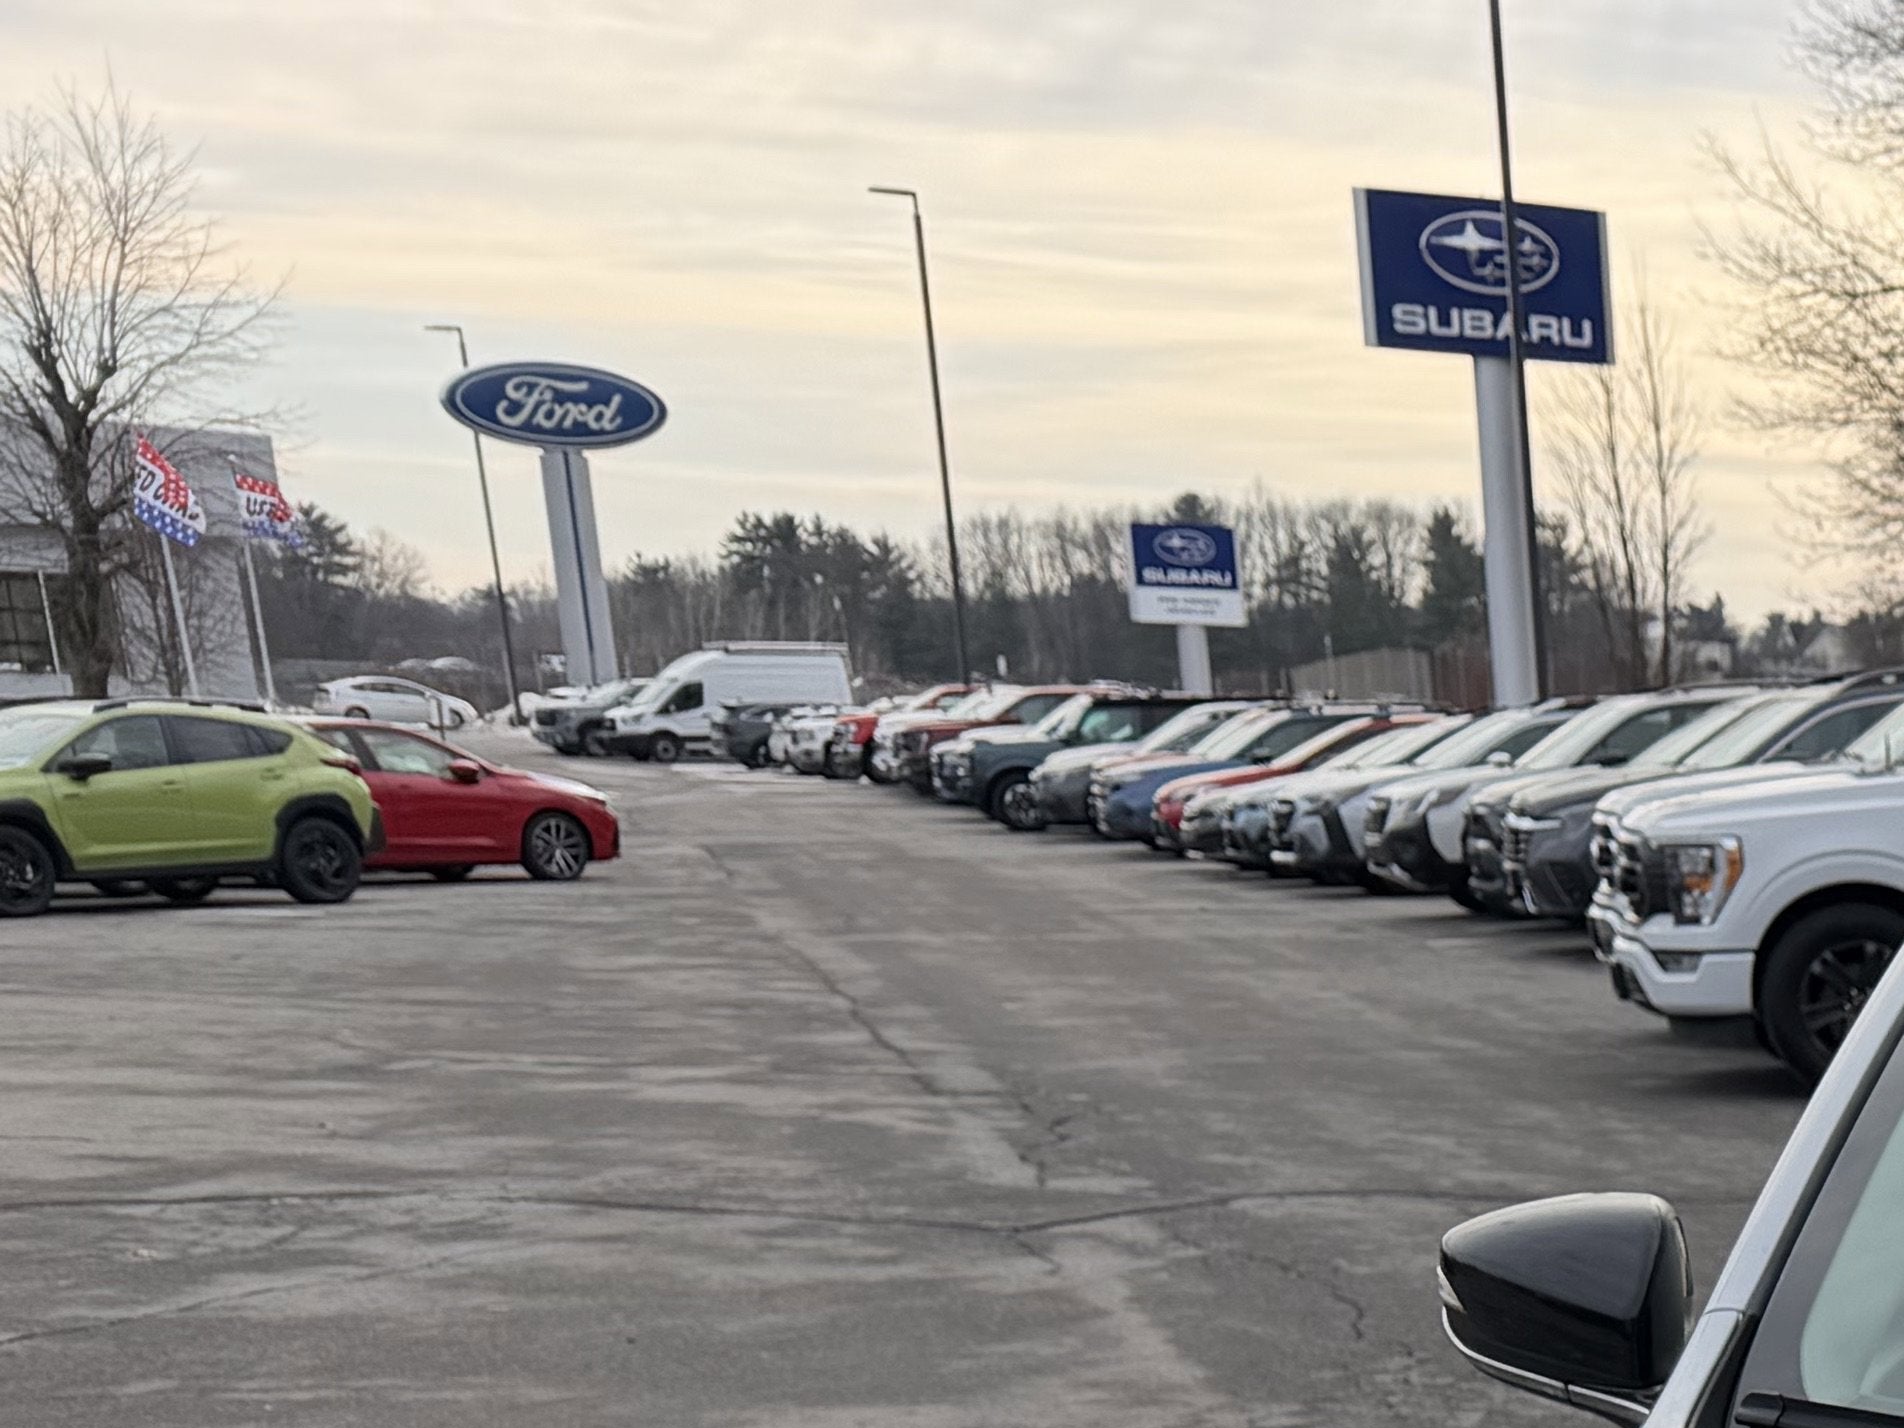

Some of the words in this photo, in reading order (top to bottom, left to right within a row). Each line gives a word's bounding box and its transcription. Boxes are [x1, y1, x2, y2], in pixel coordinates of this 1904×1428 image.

[1391, 302, 1594, 349] SUBARU
[496, 374, 623, 431] Ford
[1142, 566, 1233, 587] SUBARU
